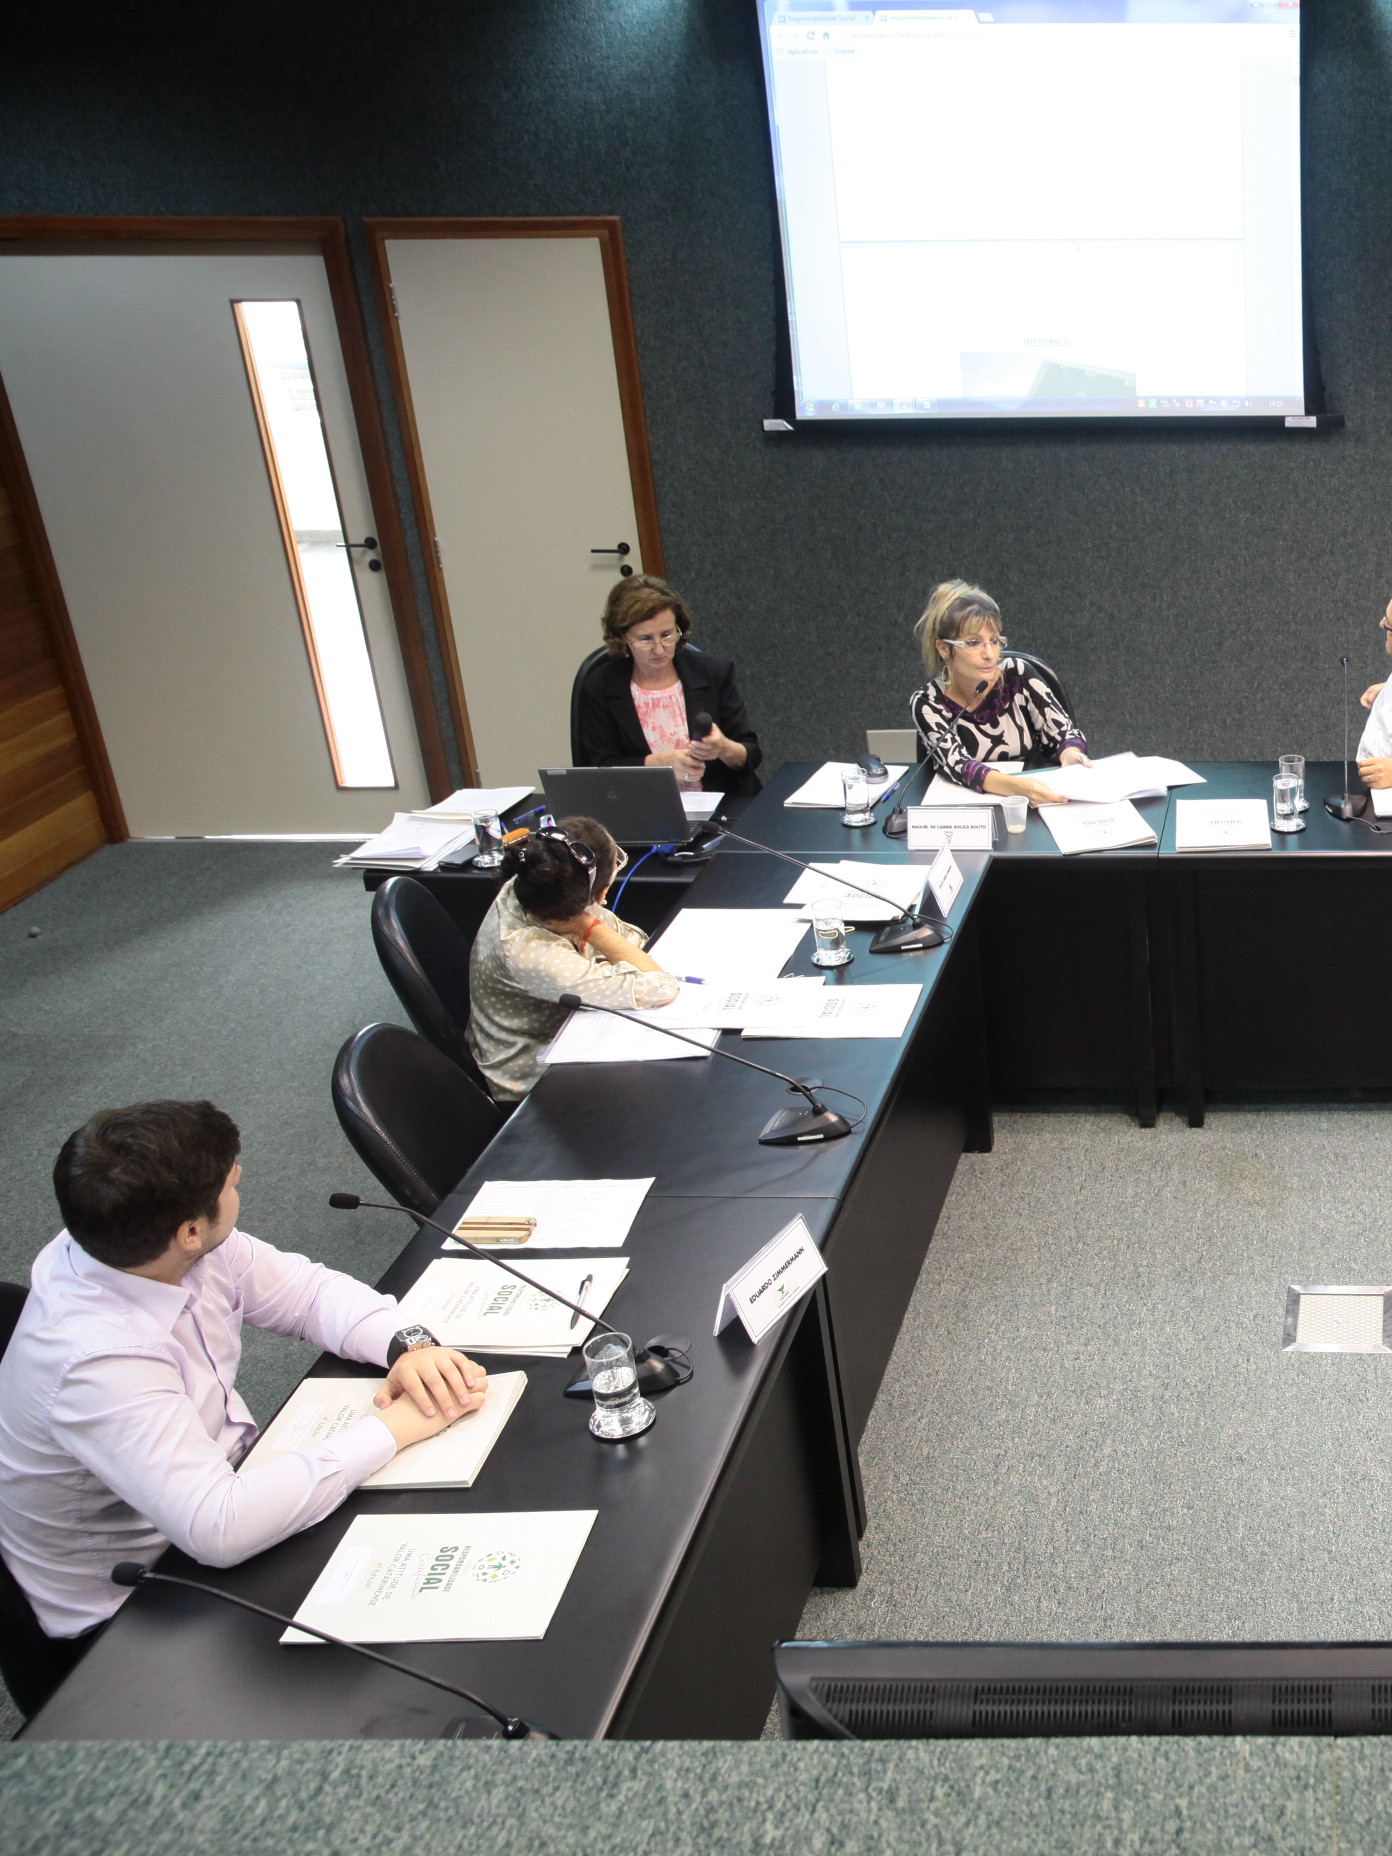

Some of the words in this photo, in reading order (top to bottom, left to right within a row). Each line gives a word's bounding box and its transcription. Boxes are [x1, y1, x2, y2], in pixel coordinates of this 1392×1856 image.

[749, 1278, 773, 1304] EDUARDO
[772, 1246, 805, 1281] ZIMMERMANN
[483, 1284, 517, 1316] SOCIAL
[393, 1542, 409, 1564] VALOR
[418, 1545, 459, 1593] SOCIAL
[367, 1564, 396, 1608] CATARINENSE
[391, 1563, 407, 1590] ATITUDE
[382, 1591, 393, 1601] DE
